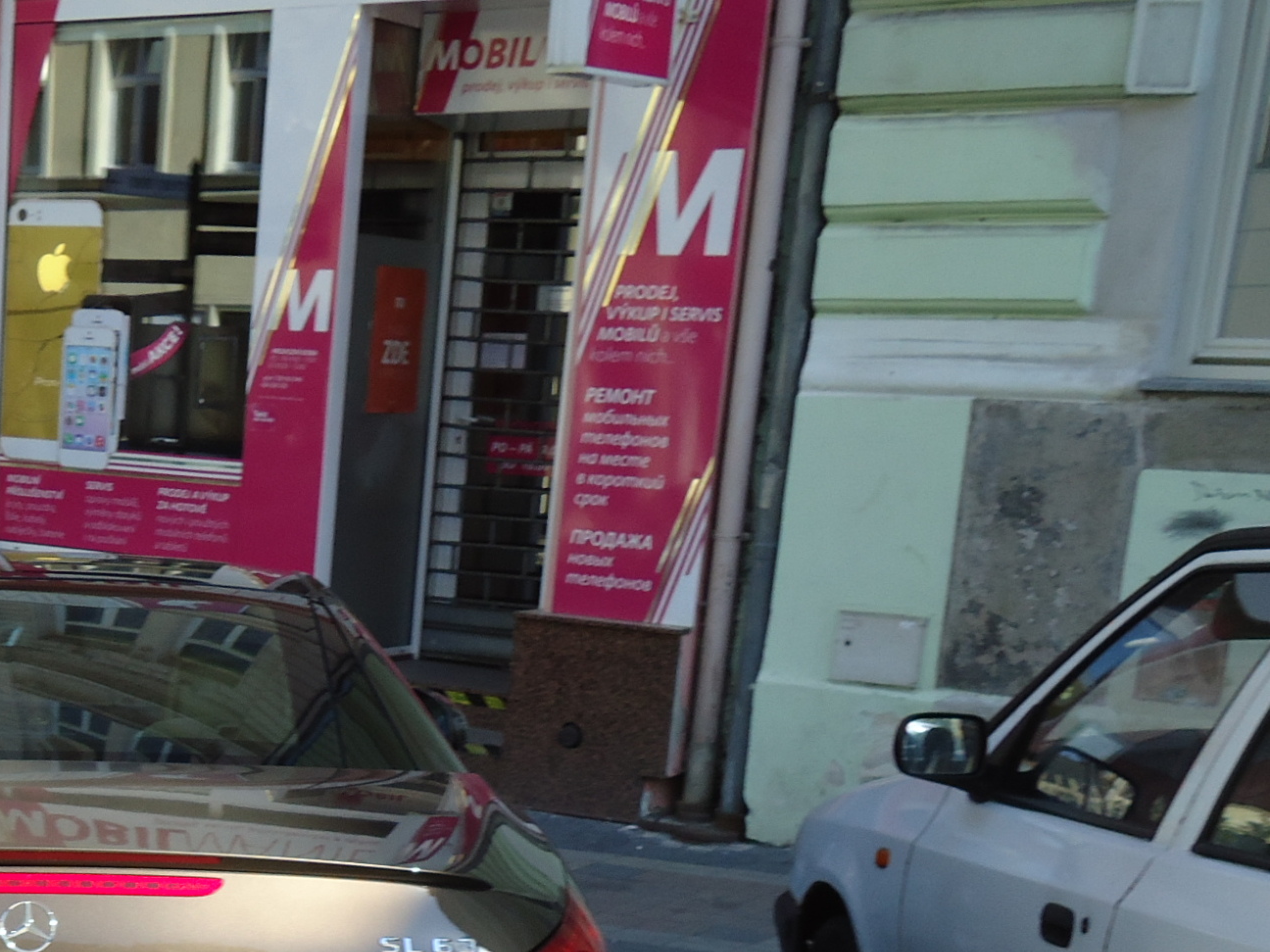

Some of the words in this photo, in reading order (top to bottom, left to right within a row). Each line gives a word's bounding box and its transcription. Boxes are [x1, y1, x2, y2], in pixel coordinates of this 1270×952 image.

[614, 284, 679, 301] PRODEJ,
[606, 302, 660, 321] VÝKUP
[668, 307, 723, 322] SERVIS
[596, 323, 660, 342] MOBILŮ
[585, 386, 657, 406] РЕМОНТ
[569, 528, 654, 551] ПРОДАЖА
